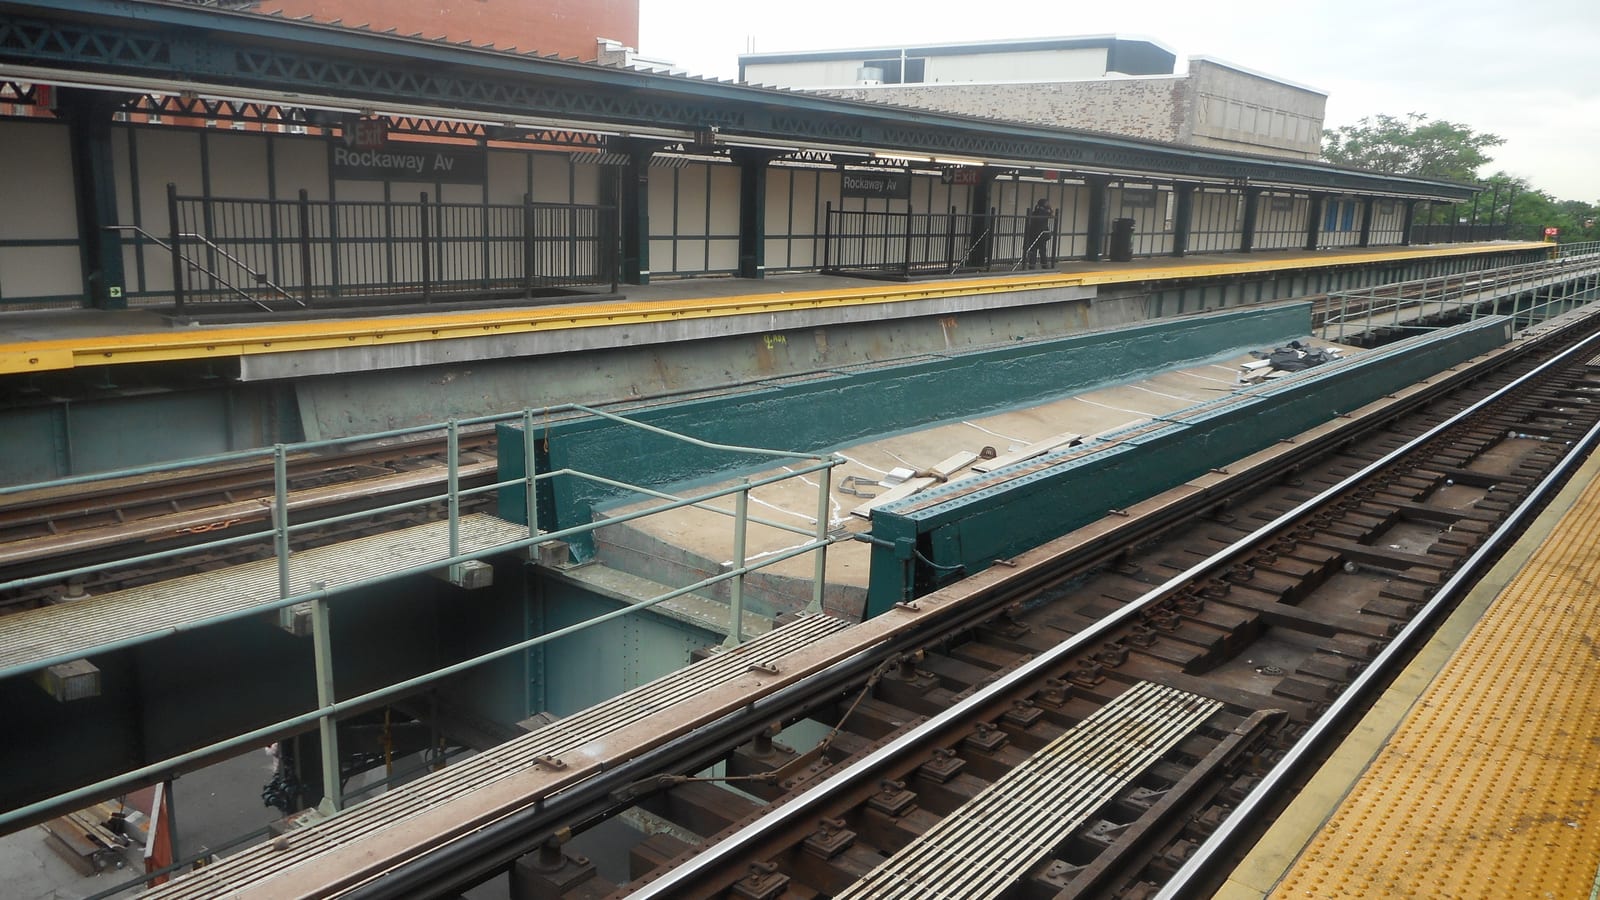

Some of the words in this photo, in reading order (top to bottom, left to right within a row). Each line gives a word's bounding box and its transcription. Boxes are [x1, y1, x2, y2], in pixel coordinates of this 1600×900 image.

[355, 122, 382, 145] Exit
[334, 147, 425, 173] Rockaway
[433, 153, 454, 170] Av
[843, 176, 884, 192] Rockaway
[886, 179, 897, 190] Av
[954, 168, 977, 183] Exit
